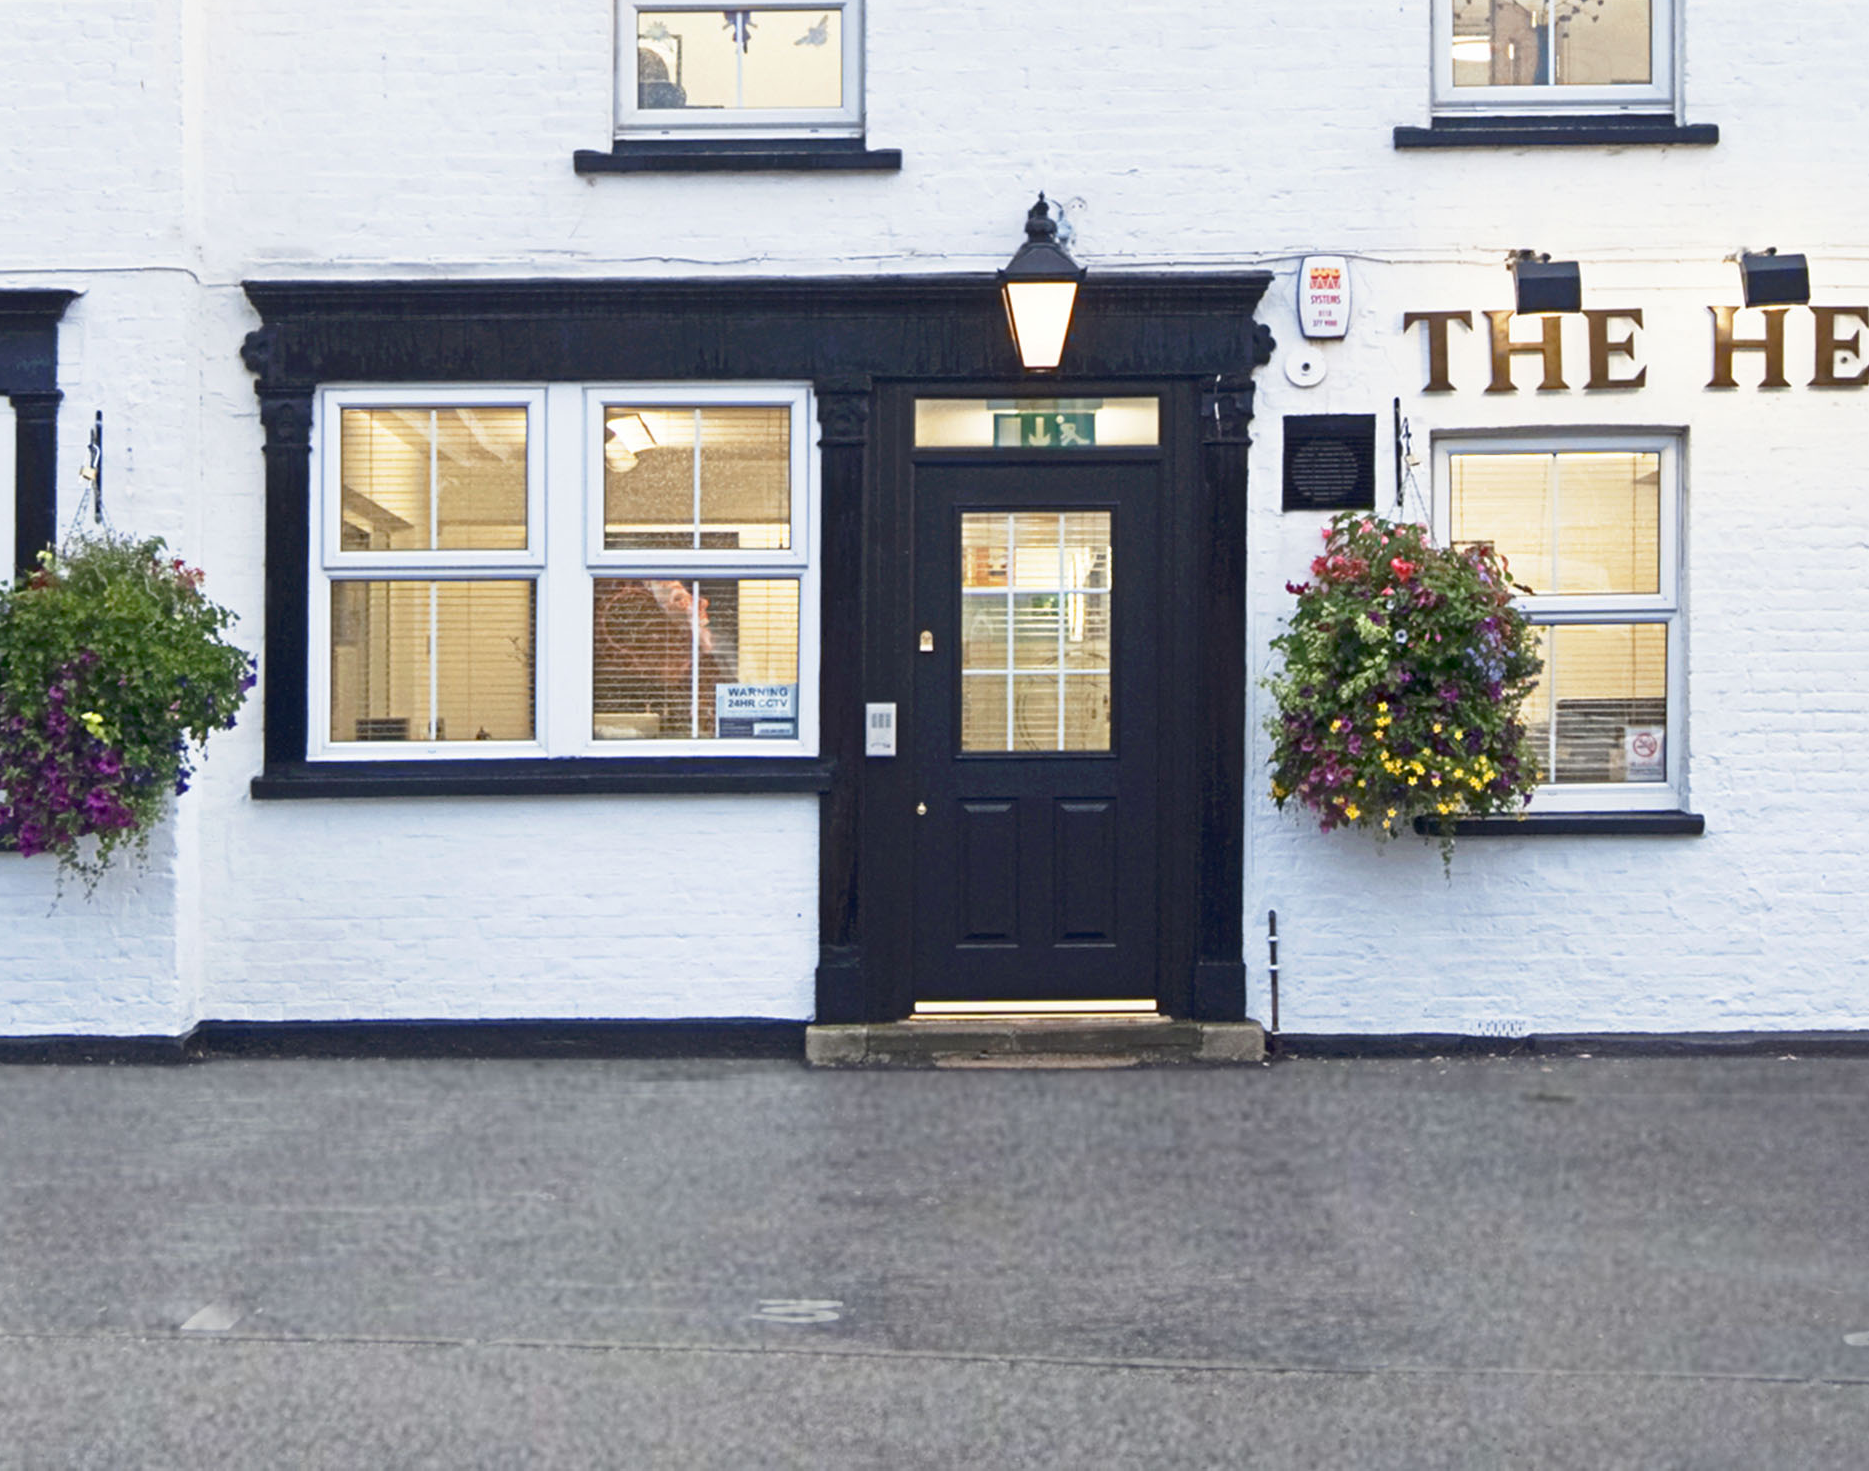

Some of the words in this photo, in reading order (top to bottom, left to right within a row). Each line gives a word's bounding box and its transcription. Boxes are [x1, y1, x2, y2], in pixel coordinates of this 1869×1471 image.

[1310, 294, 1341, 305] SYSTEMS
[1403, 308, 1648, 393] THE
[727, 686, 789, 697] WARNING
[728, 698, 755, 708] 24HR
[758, 698, 788, 708] CCTV
